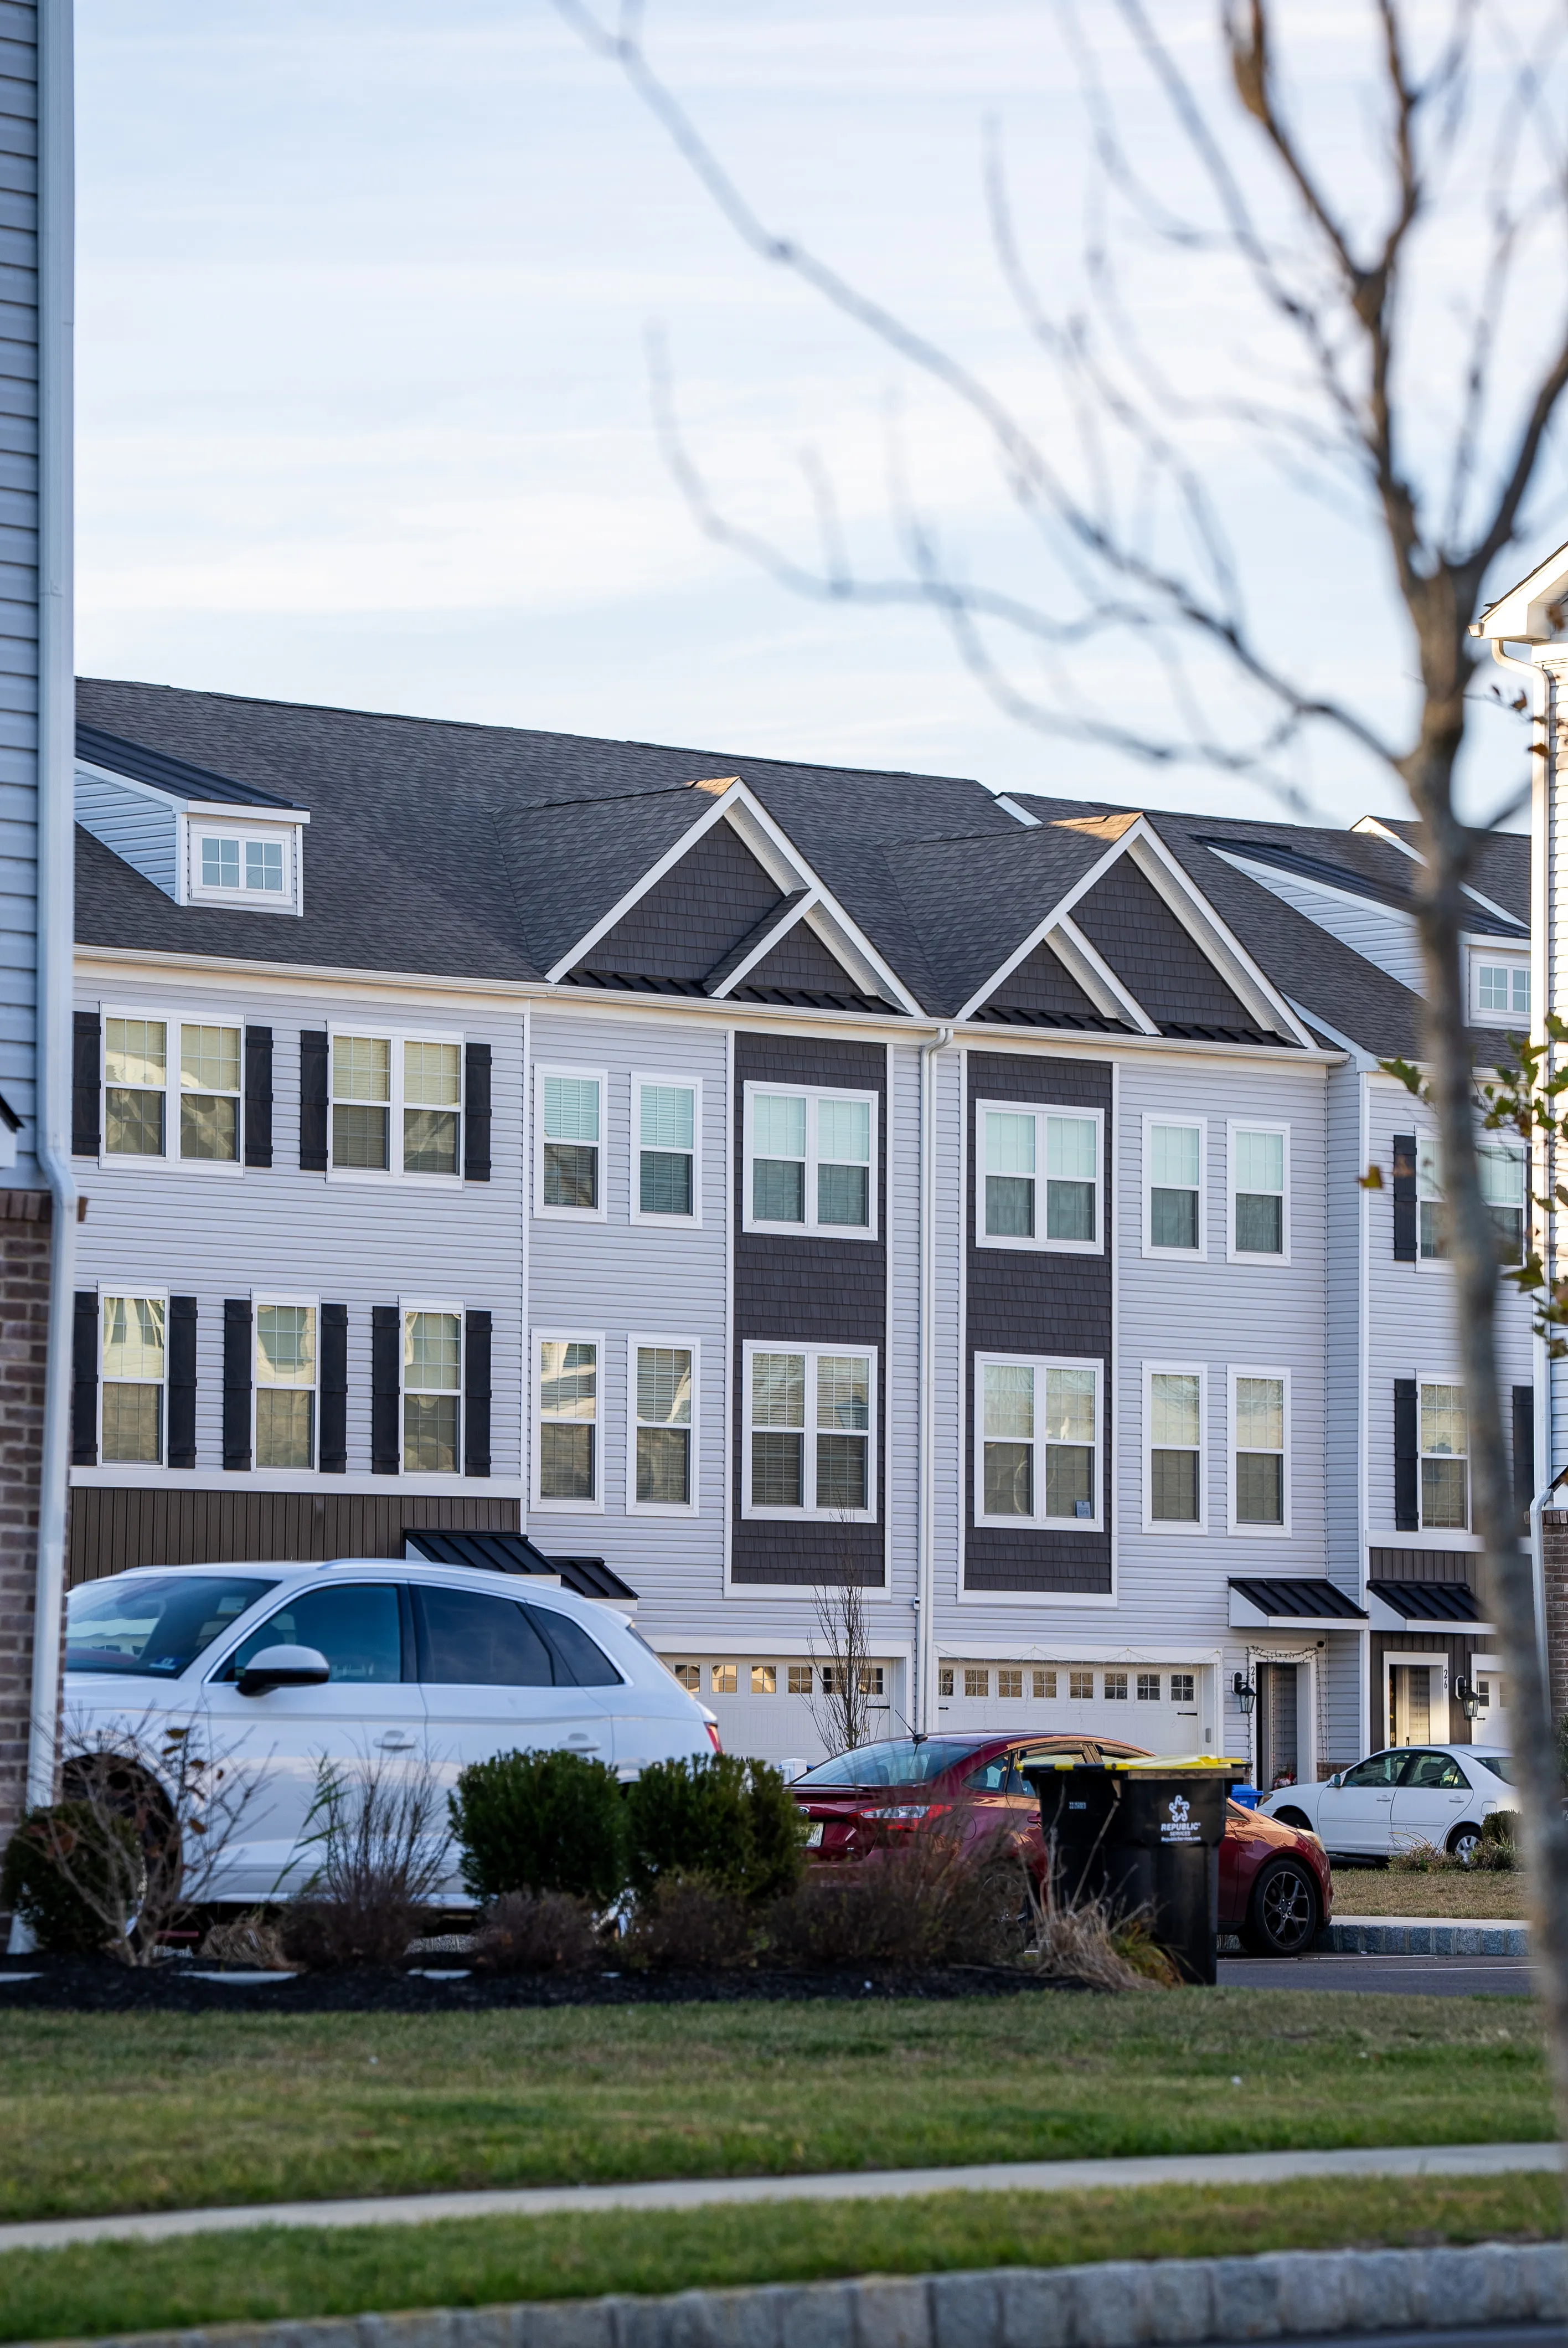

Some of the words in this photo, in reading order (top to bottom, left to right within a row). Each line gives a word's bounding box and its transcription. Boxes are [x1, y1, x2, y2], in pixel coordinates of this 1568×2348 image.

[1251, 1666, 1255, 1686] 24
[1443, 1669, 1448, 1689] 26
[1160, 1822, 1199, 1831] REPUBLIC
